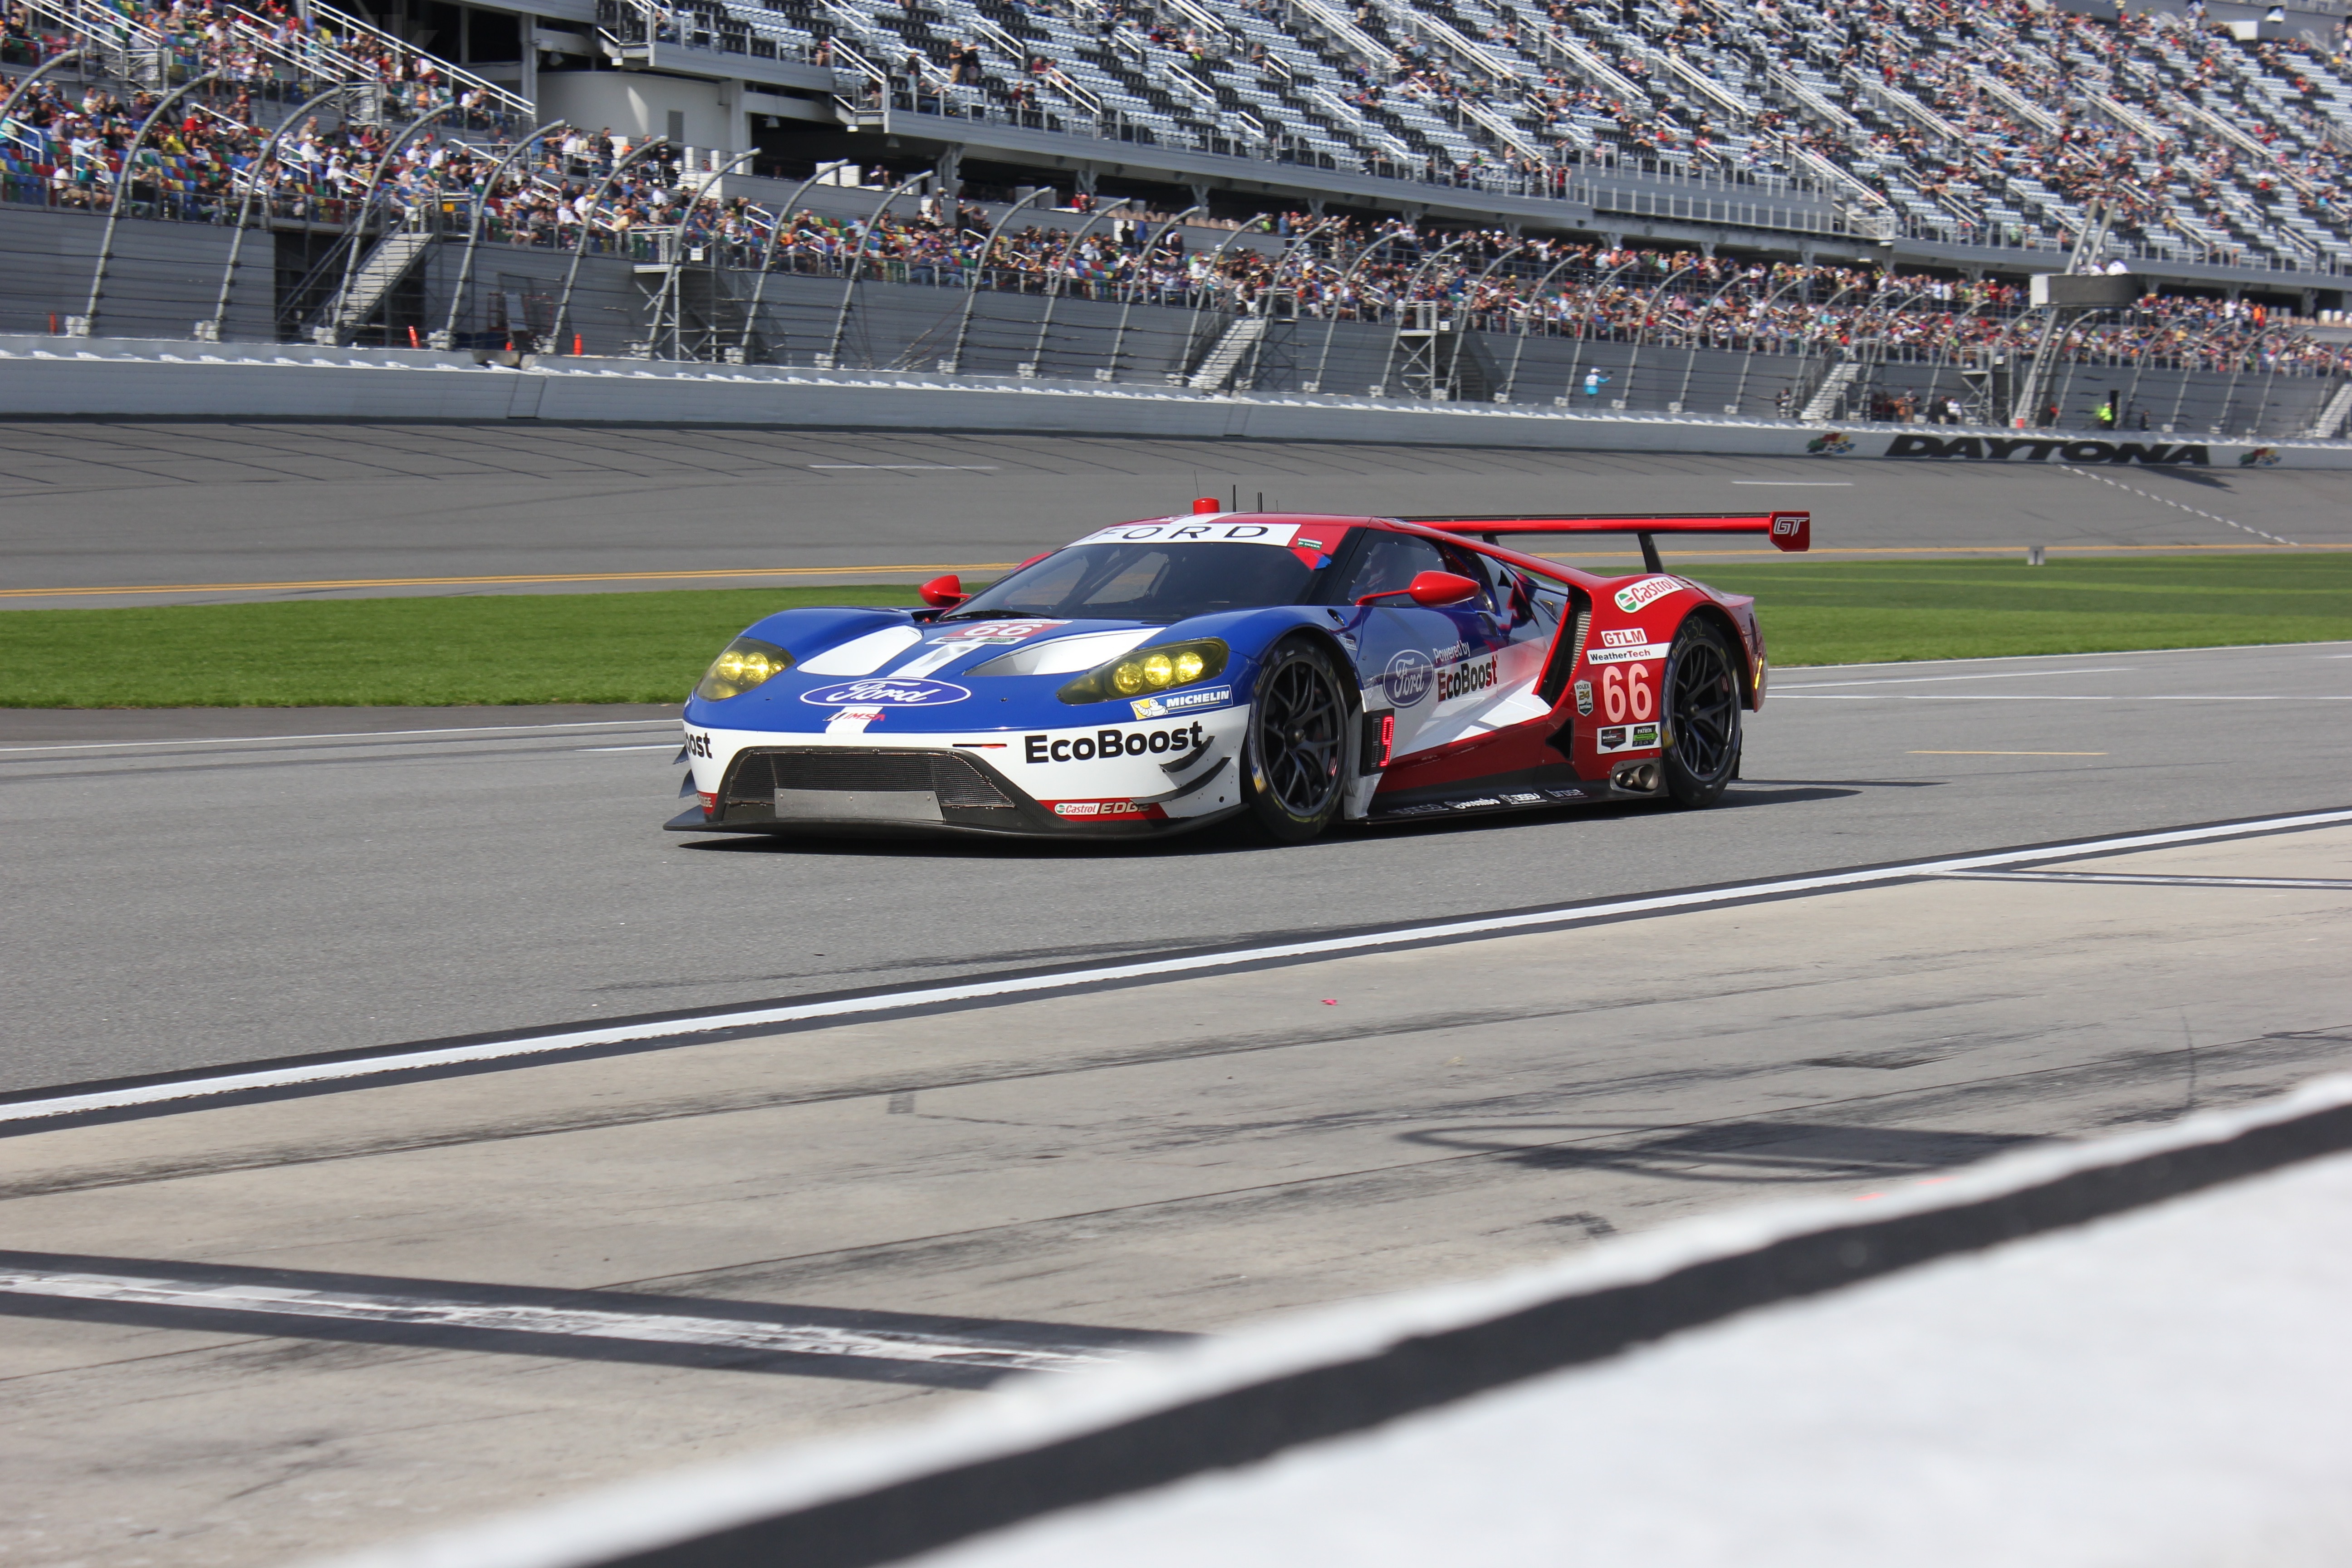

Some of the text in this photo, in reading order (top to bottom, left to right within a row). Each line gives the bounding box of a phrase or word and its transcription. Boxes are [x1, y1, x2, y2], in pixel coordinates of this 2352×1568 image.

[1885, 434, 2210, 465] DAYTONA
[1089, 526, 1269, 540] FORD
[1773, 517, 1809, 537] GT
[1631, 578, 1678, 603] Castrol
[964, 624, 1043, 636] 66
[1604, 630, 1645, 645] GTLM
[1432, 639, 1470, 664] Powered by
[1590, 649, 1651, 661] WeatherTech
[1394, 657, 1425, 699] Ford
[1437, 654, 1497, 702] EcoBoost
[826, 680, 942, 702] Ford
[1166, 690, 1230, 707] MICHELIN
[1578, 690, 1590, 701] 24
[1602, 663, 1652, 723] 66
[1024, 721, 1203, 764] EcoBoost
[1065, 802, 1150, 814] Castrol EDGE
